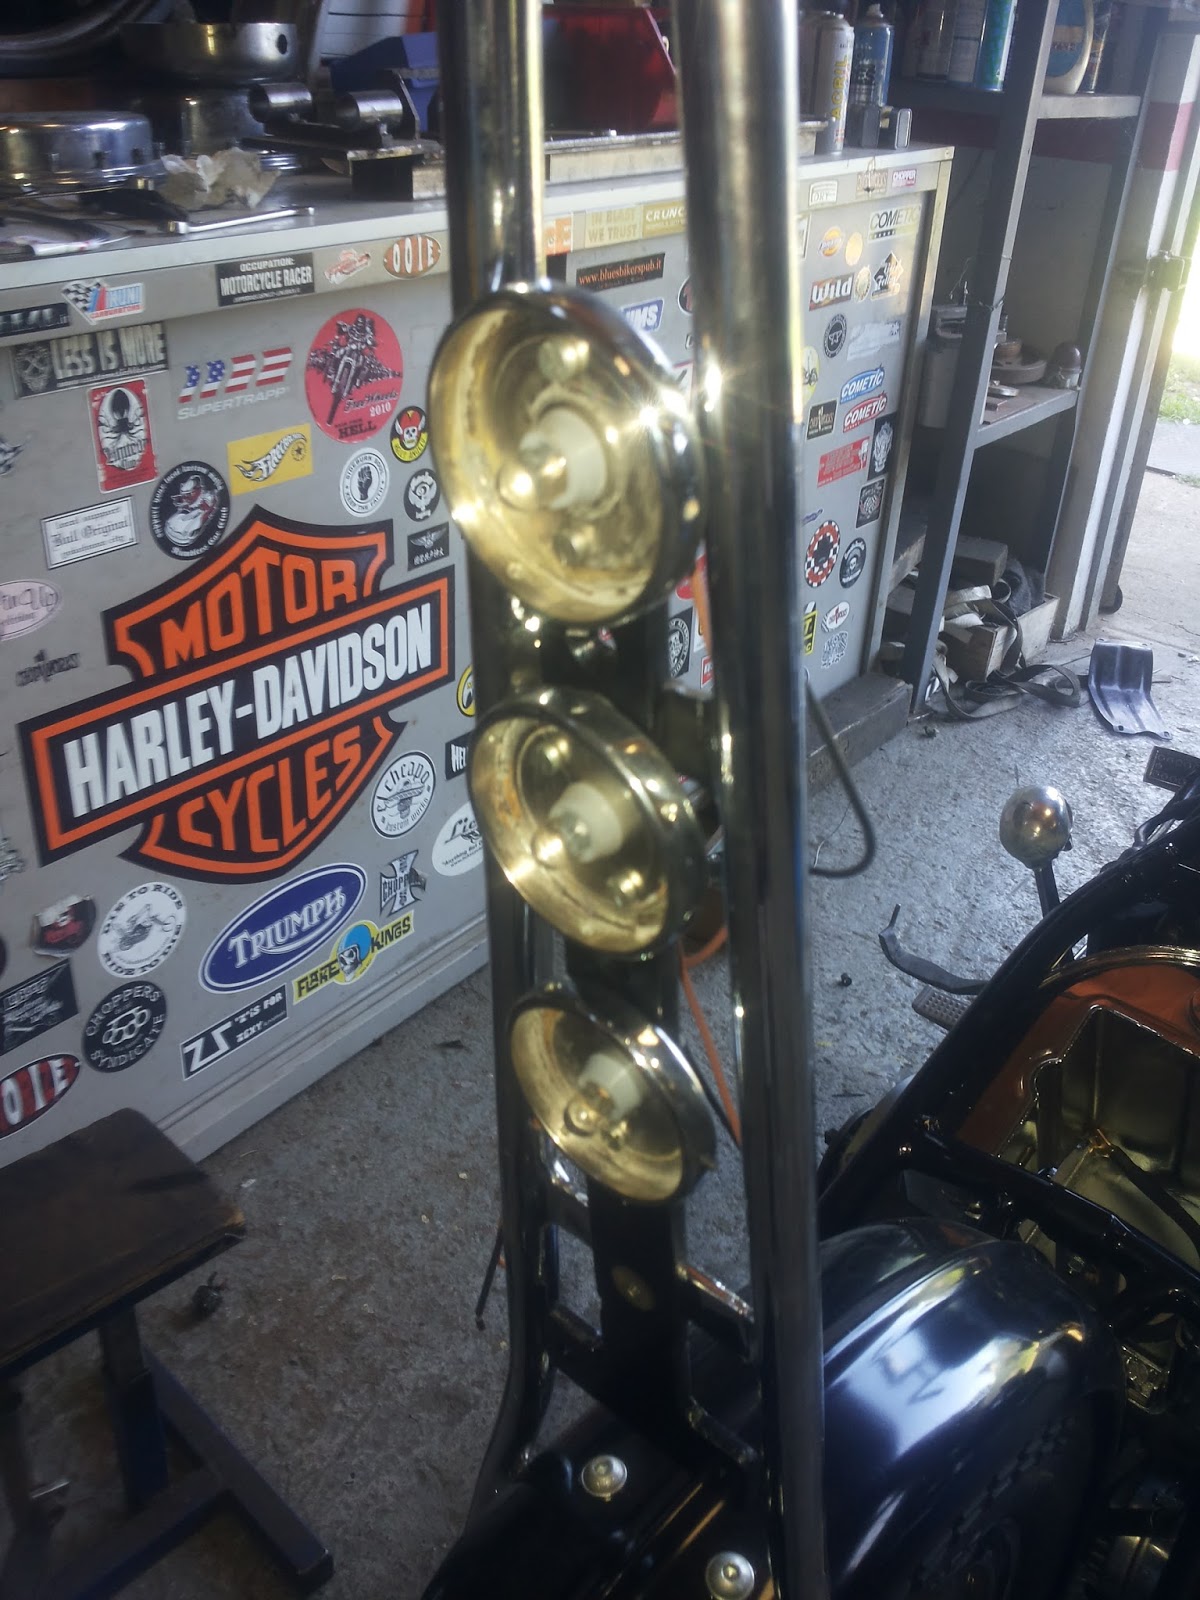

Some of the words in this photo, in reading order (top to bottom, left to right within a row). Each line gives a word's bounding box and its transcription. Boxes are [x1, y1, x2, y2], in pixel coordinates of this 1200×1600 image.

[588, 228, 605, 242] WE
[607, 224, 637, 240] TRUST
[239, 257, 296, 272] OCCUPATION:
[578, 257, 662, 286] www.bluesbikerspub.it
[220, 270, 283, 296] MOTORCYCLE
[283, 266, 313, 287] RACER
[811, 277, 853, 304] Wild
[841, 369, 884, 397] COMETIC
[369, 401, 392, 417] 2010
[844, 397, 888, 427] COMETIC
[338, 420, 377, 440] HELL
[160, 546, 357, 669] MOTOR
[63, 602, 431, 818] HARLEY-DAVIDSON
[178, 724, 361, 853] CYCLES
[128, 886, 149, 900] TO
[152, 884, 183, 910] RIDE
[228, 886, 347, 969] TRIUMPH
[103, 953, 136, 977] RIDE
[140, 959, 161, 974] TO
[297, 958, 340, 998] FLAKE
[263, 992, 283, 1010] FOR
